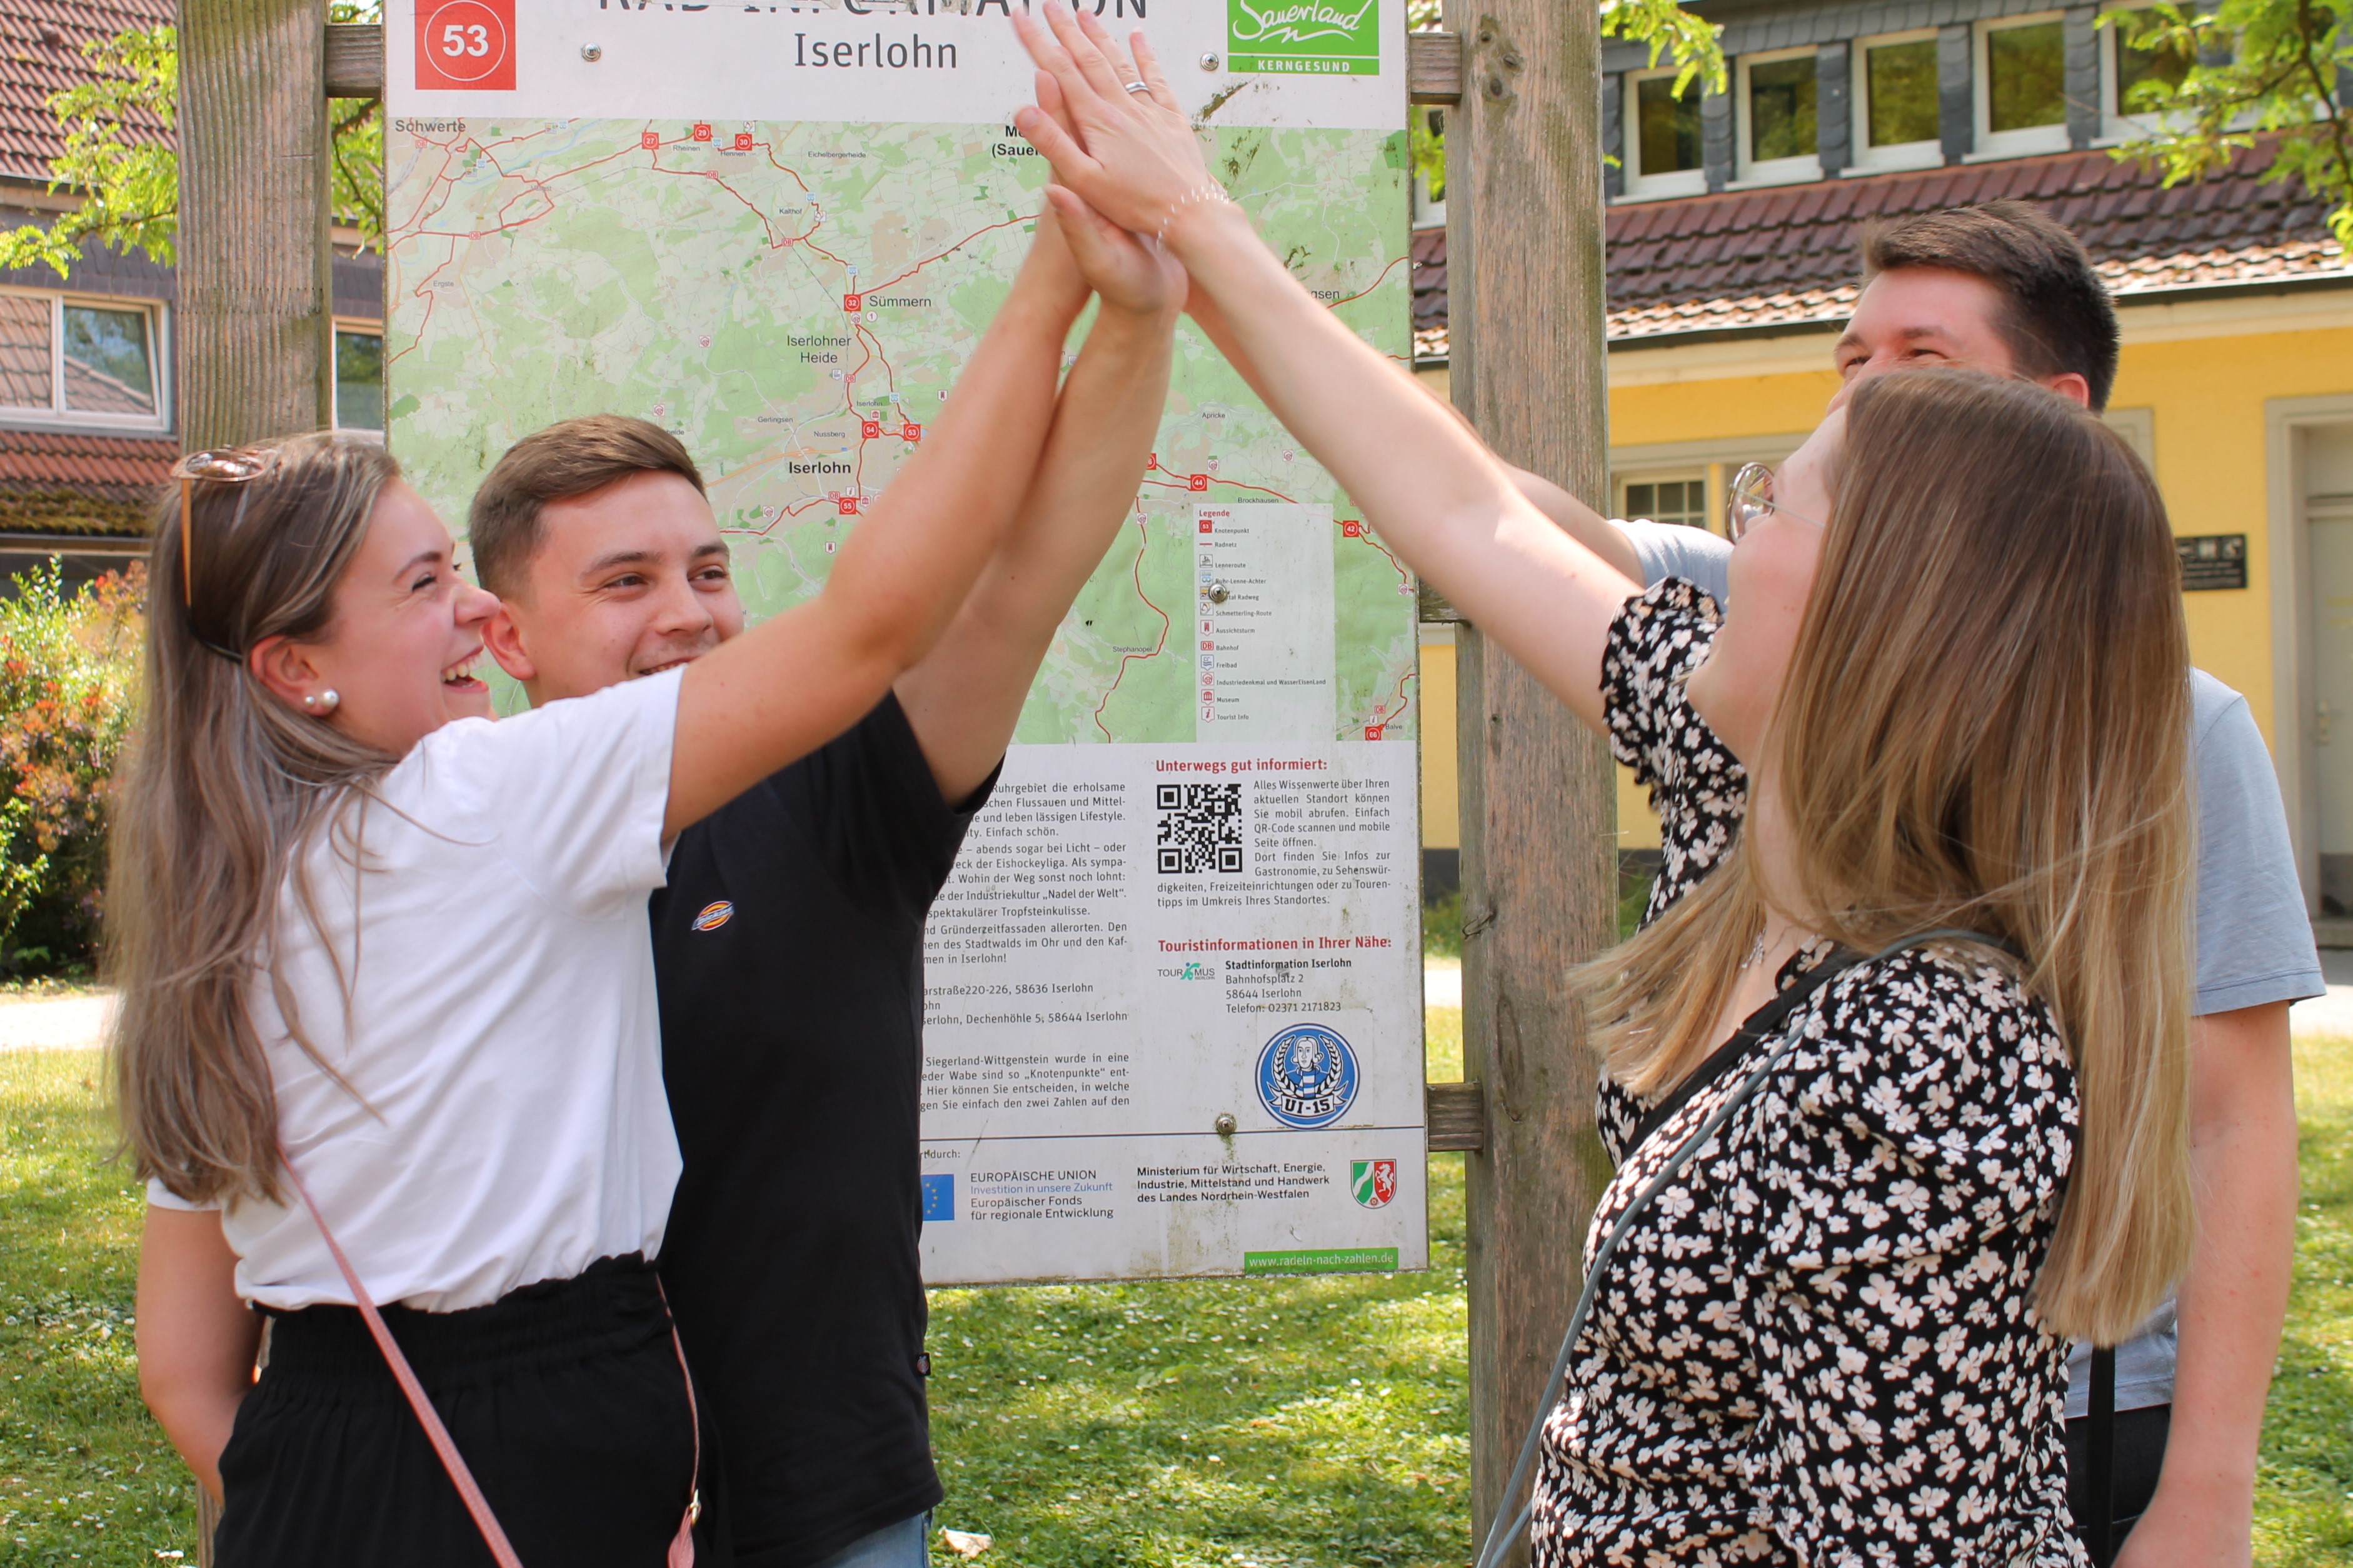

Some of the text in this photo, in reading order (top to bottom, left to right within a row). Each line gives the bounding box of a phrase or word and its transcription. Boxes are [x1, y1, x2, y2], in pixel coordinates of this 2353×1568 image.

[1233, 0, 1372, 40] Sauerland
[443, 25, 489, 56] 53
[795, 33, 956, 68] Iserlohn
[1258, 60, 1350, 72] KERNGESUND
[395, 119, 466, 133] Schwerte
[870, 296, 931, 307] Sümmern
[788, 335, 851, 346] Iserlohner
[801, 352, 838, 363] Heide
[790, 462, 851, 474] Iserlohn
[1156, 758, 1327, 774] Unterwegs gut informiert:
[1053, 782, 1067, 792] die
[1073, 782, 1125, 792] erholsame
[1254, 779, 1389, 790] Alles Wissenwerte über Ihren
[1016, 797, 1125, 807] Flussauen und Mittel-
[1254, 793, 1389, 804] aktuellen Standort können
[984, 811, 1125, 823] und leben lässigen Lifestyle.
[1255, 807, 1389, 818] Sie mobil abrufen. Einfach
[1255, 823, 1295, 834] QR-Code
[1339, 822, 1355, 831] und
[1359, 822, 1390, 831] mobile
[1255, 837, 1316, 847] Seite öffnen.
[1255, 852, 1275, 862] Dort
[1284, 852, 1314, 861] finden
[1323, 851, 1337, 861] Sie
[1345, 851, 1368, 860] Infos
[1255, 866, 1320, 876] Gastronomie,
[1336, 865, 1390, 875] Sehenswür-
[1158, 882, 1207, 894] digkeiten,
[1210, 881, 1313, 892] Freizeiteinrichtungen
[1317, 880, 1338, 889] oder
[1355, 878, 1390, 889] Touren-
[1158, 895, 1329, 909] tipps im Umkreis Ihres Standortes.
[928, 906, 1090, 919] spektakulärer Tropfsteinkulisse.
[1158, 936, 1391, 952] Touristinformationen in Ihrer Nähe:
[1225, 958, 1351, 969] Stadtinformation Iserlohn
[1226, 974, 1303, 986] Bahnhofsplatz 2
[1227, 988, 1301, 999] 58644 Iserlohn
[1227, 1002, 1341, 1013] Telefon: 02371 2171823
[966, 1013, 1031, 1024] Dechenhöhle
[1049, 1012, 1081, 1022] 58644
[1086, 1011, 1126, 1021] Iserlohn
[926, 1053, 1128, 1068] Siegerland-Wittgenstein wurde in eine
[1285, 1099, 1330, 1114] UI-15
[1138, 1163, 1325, 1176] Ministerium für Wirtschaft, Energie,
[971, 1170, 1096, 1182] EUROPÄISCHE UNION
[971, 1185, 1023, 1195] Investition
[1026, 1185, 1035, 1193] in
[1074, 1182, 1113, 1192] Zukunft
[1138, 1176, 1329, 1189] Industrie, Mittelstand und Handwerk
[1138, 1190, 1309, 1202] des Landes Nordrhein-Westfalen
[971, 1196, 1082, 1209] Europäischer Fonds
[971, 1208, 1113, 1221] für regionale Entwicklung
[1249, 1254, 1393, 1267] www.radeln-nach-zahlen.de
